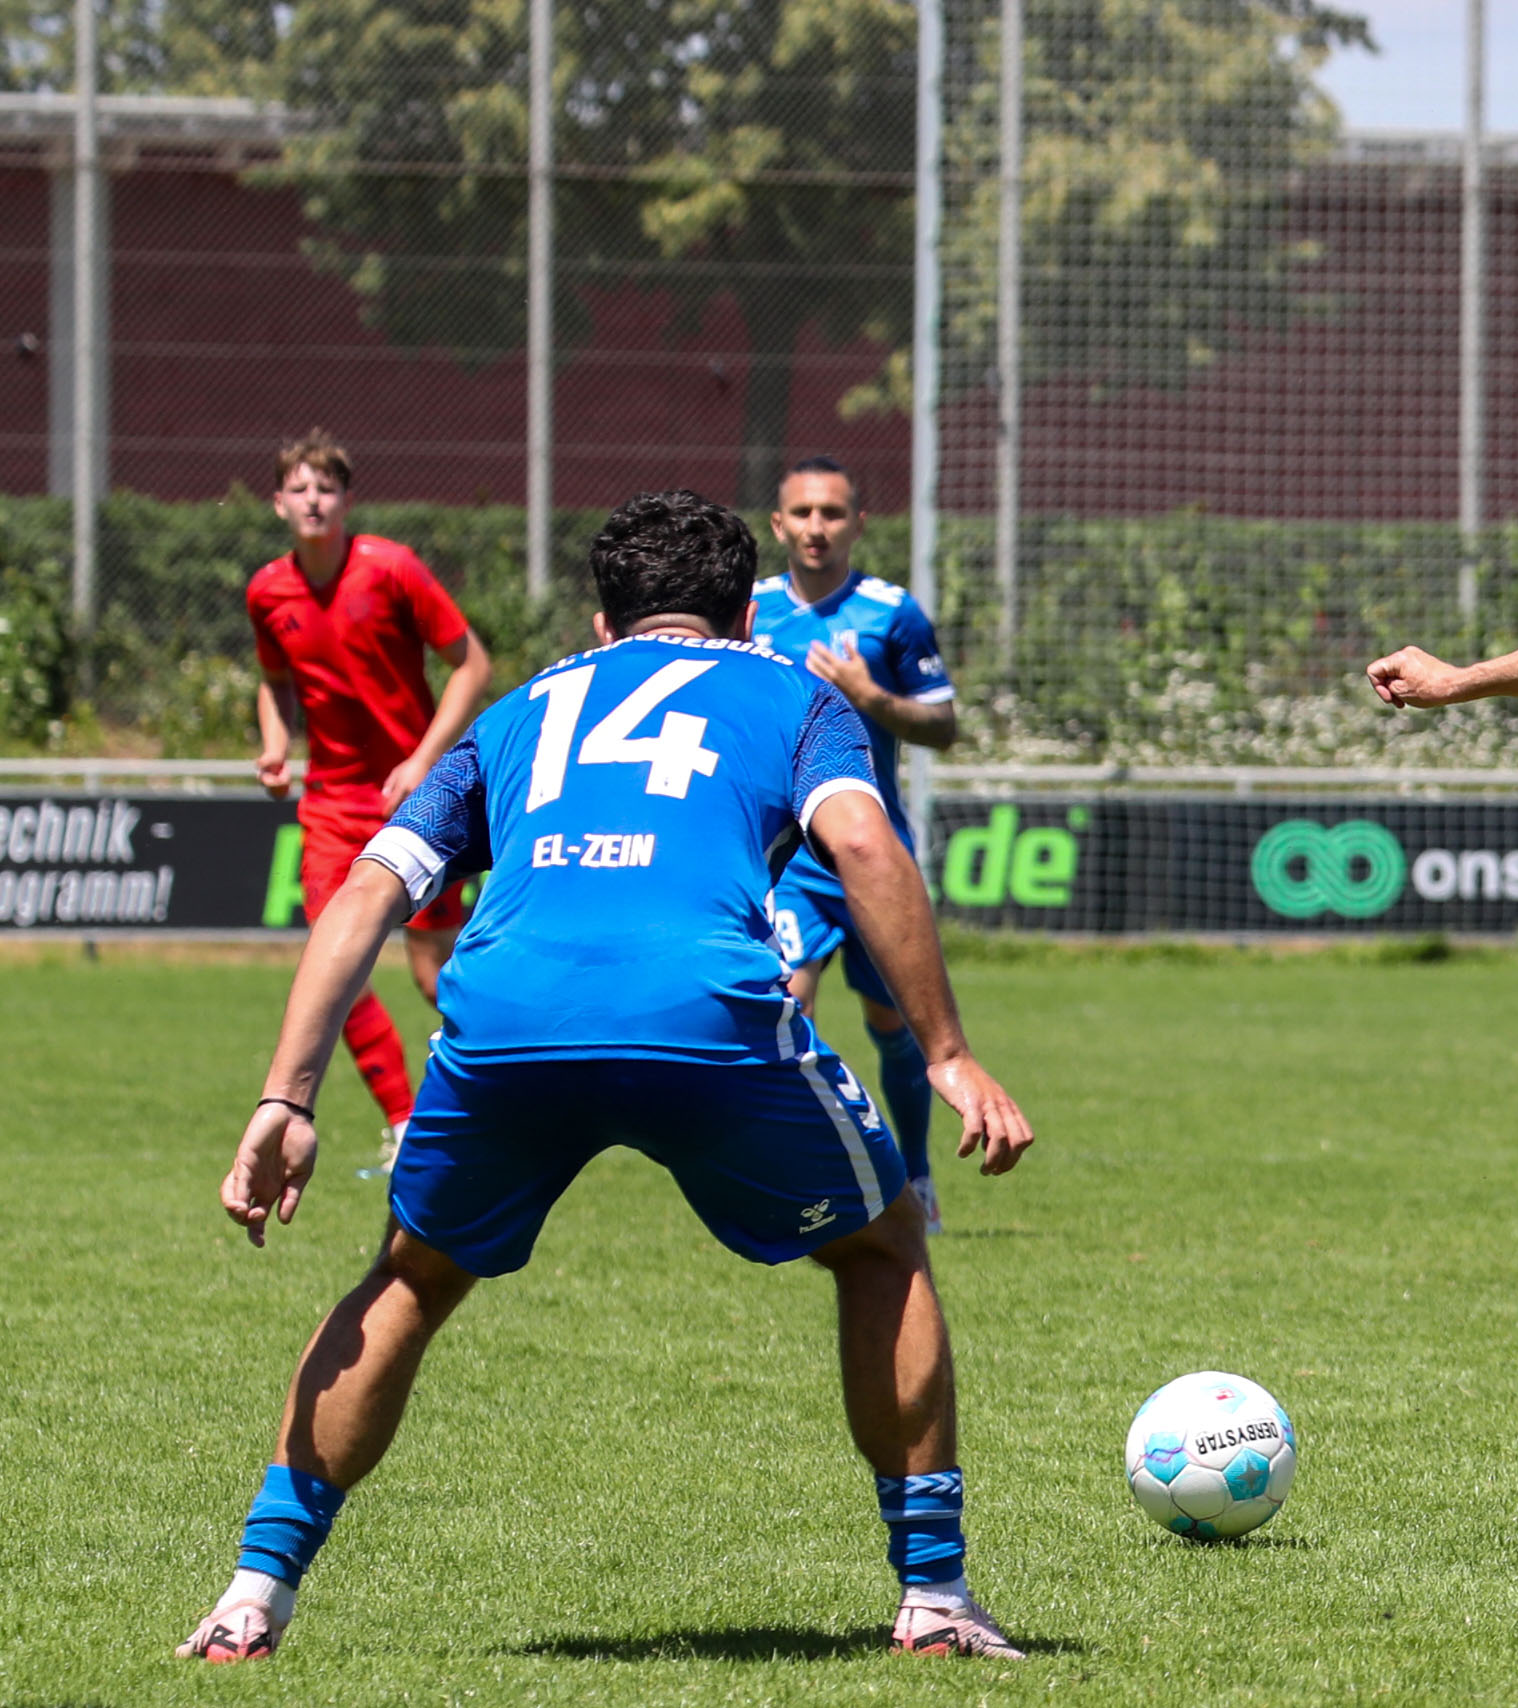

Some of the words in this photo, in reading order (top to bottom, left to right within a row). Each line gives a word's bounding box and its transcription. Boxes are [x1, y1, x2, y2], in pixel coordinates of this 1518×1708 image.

[525, 658, 720, 814] 14
[532, 833, 655, 868] EL-ZEIN
[1195, 1421, 1279, 1455] DERBYSTAR
